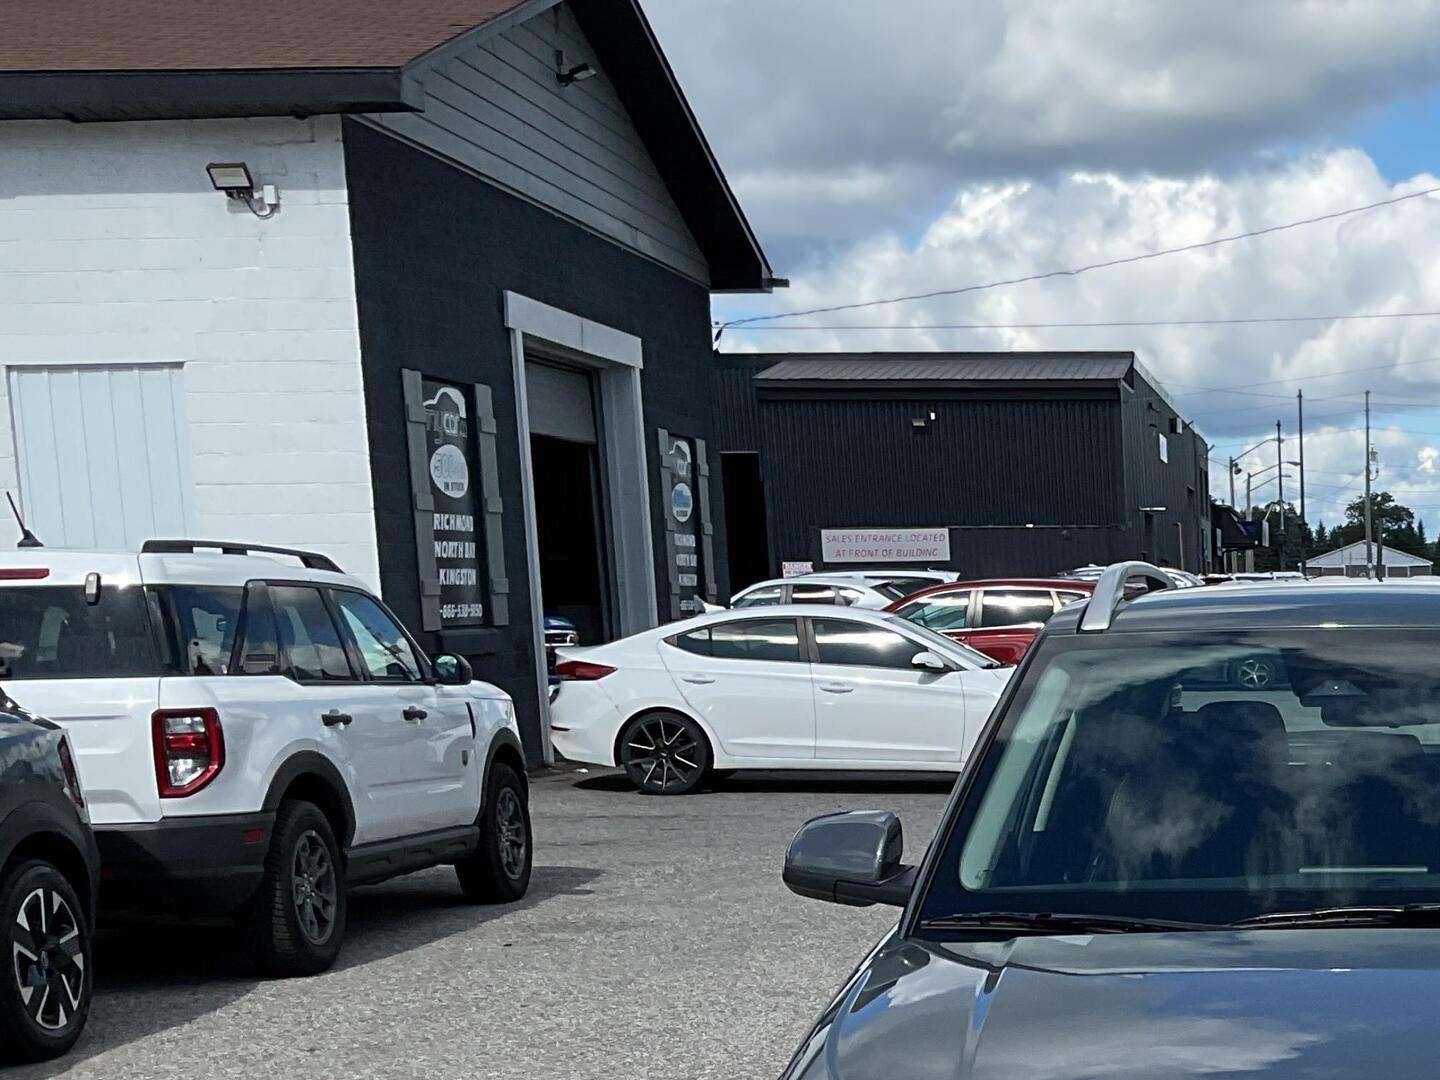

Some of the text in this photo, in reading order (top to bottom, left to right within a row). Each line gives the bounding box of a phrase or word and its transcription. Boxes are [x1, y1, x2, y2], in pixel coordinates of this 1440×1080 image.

[433, 513, 474, 532] RICHMOND
[826, 534, 945, 543] SALES ENTRANCE LOCATED
[434, 541, 464, 559] NORTH
[835, 548, 938, 558] AT FRONT OF BUILDING
[439, 568, 477, 585] KINGSTON
